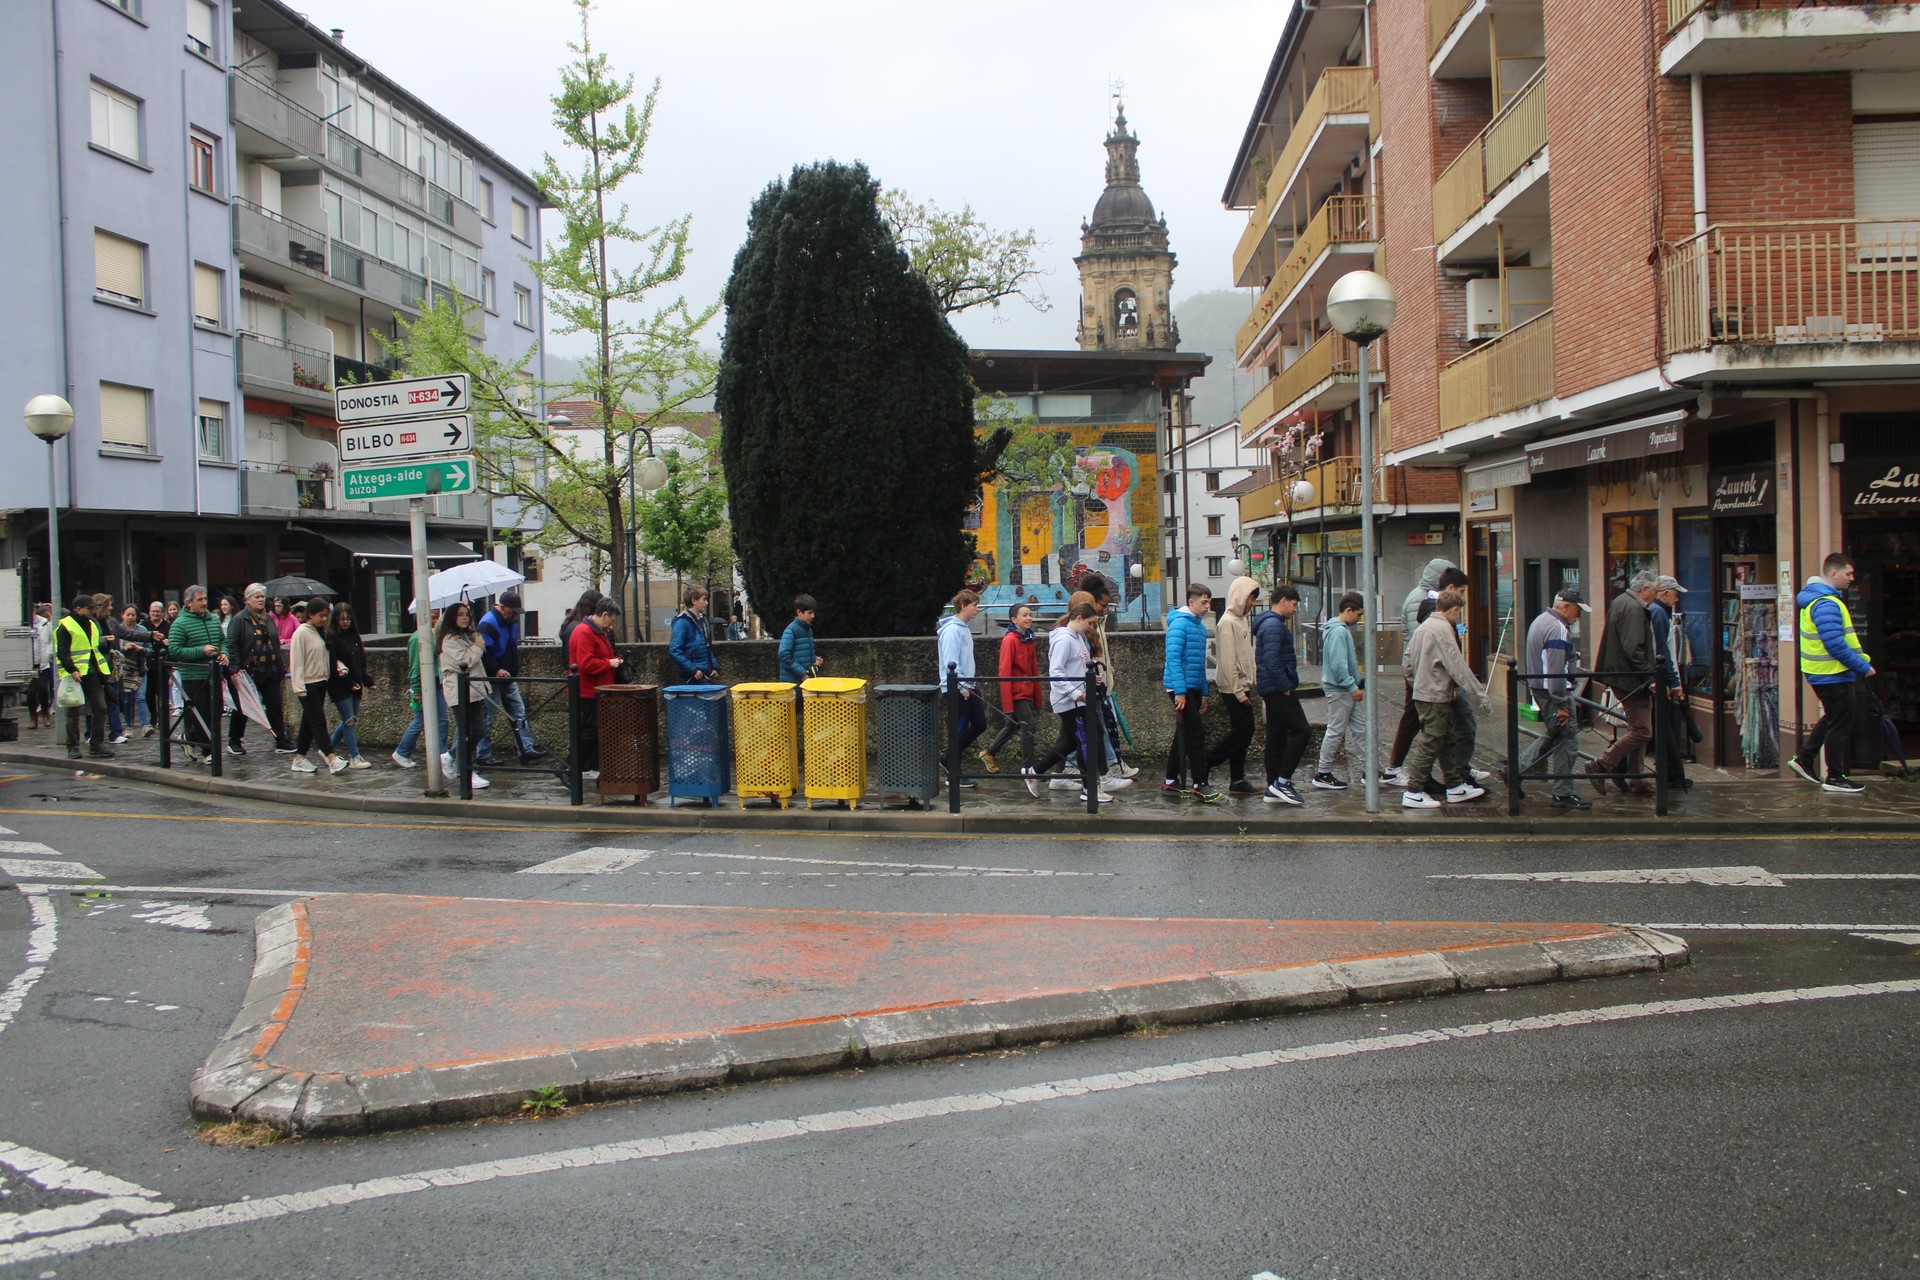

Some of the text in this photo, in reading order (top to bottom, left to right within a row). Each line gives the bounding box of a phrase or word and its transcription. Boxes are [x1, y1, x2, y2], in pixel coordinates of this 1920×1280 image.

[340, 391, 439, 411] DONOSTIA N-634
[346, 433, 416, 451] BILBO N-634
[349, 469, 423, 486] Atxega-alde
[1715, 472, 1757, 496] Laurok
[349, 485, 377, 495] auzoa
[1853, 491, 1920, 505] liburu
[1712, 496, 1757, 512] Paperdenda
